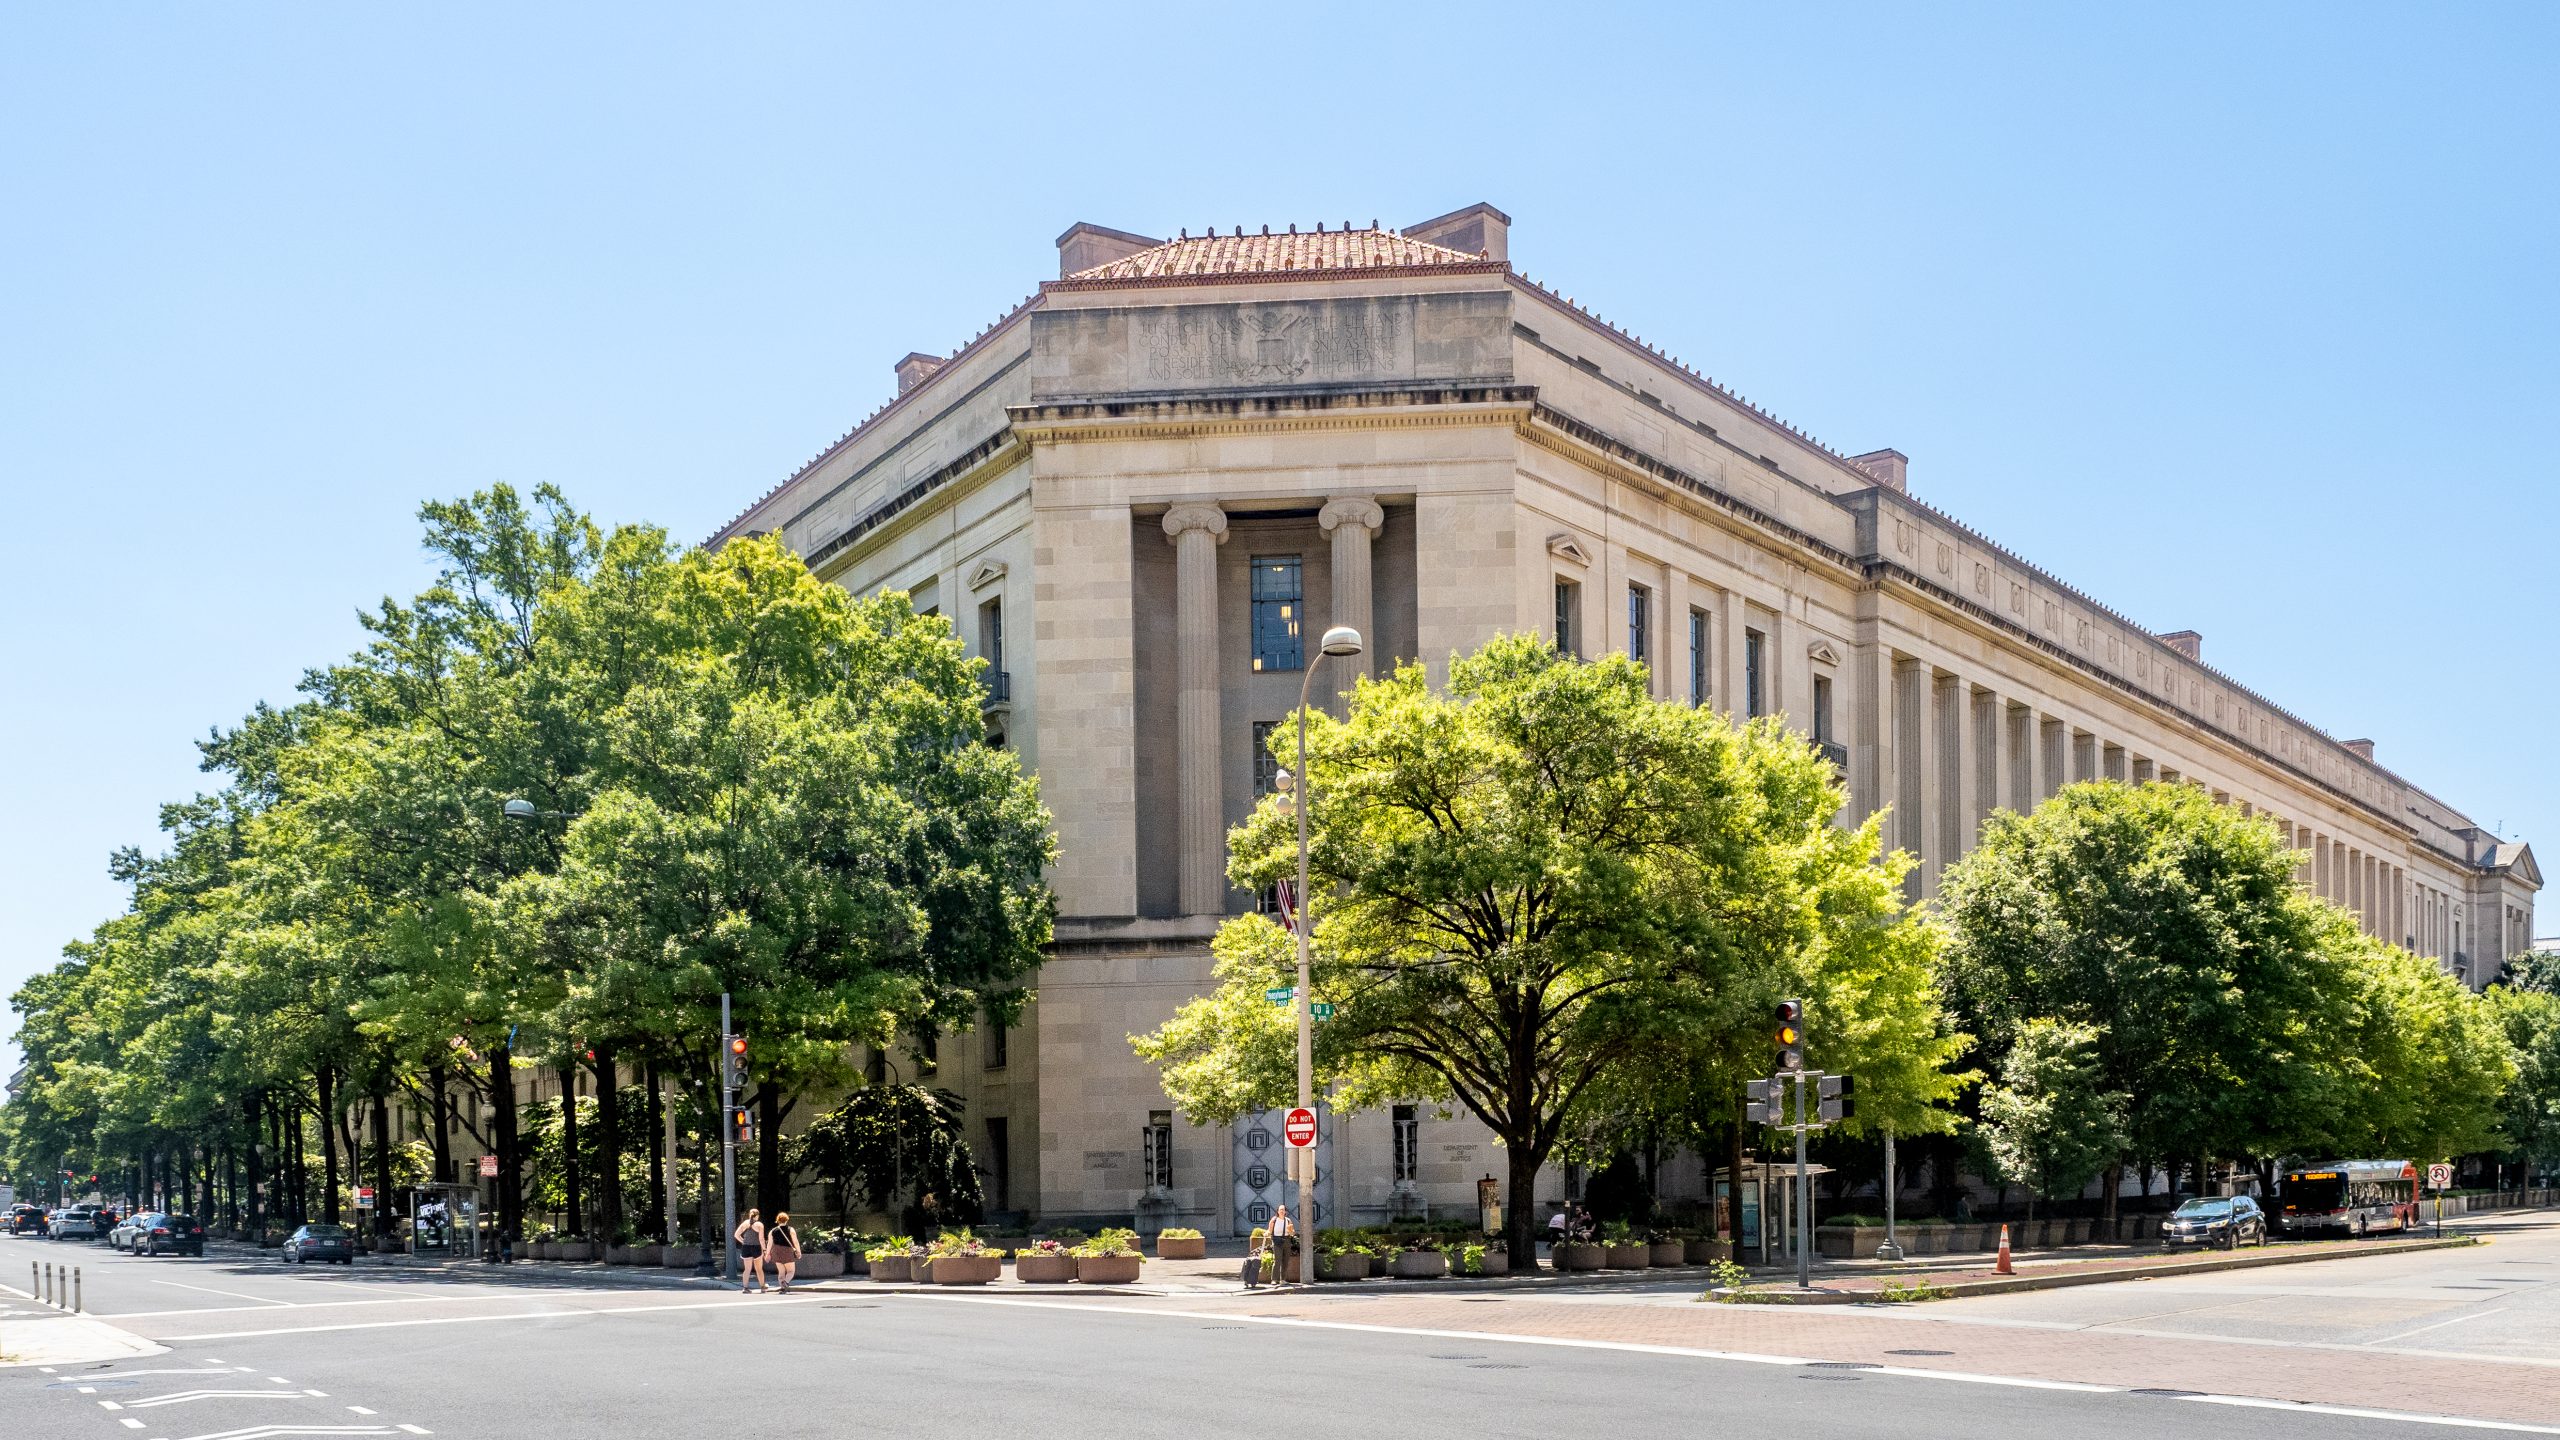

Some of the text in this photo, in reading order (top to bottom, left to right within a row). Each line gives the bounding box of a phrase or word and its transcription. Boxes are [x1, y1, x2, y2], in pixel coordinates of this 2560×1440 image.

[1142, 312, 1402, 334] JUSTICE IN THE LIFE AND
[1139, 324, 1401, 347] CONDUCT OF THE STATE IS
[1150, 337, 1394, 358] POSSIBLE ONLY AS FIRST
[1149, 348, 1394, 370] IT RESIDES IN THE HEARTS
[1147, 368, 1171, 381] AND
[1176, 367, 1214, 379] SOULS
[1312, 361, 1334, 374] THE
[1337, 360, 1394, 373] CITIZENS
[1314, 1004, 1322, 1014] 10
[1291, 1132, 1310, 1140] ENTER
